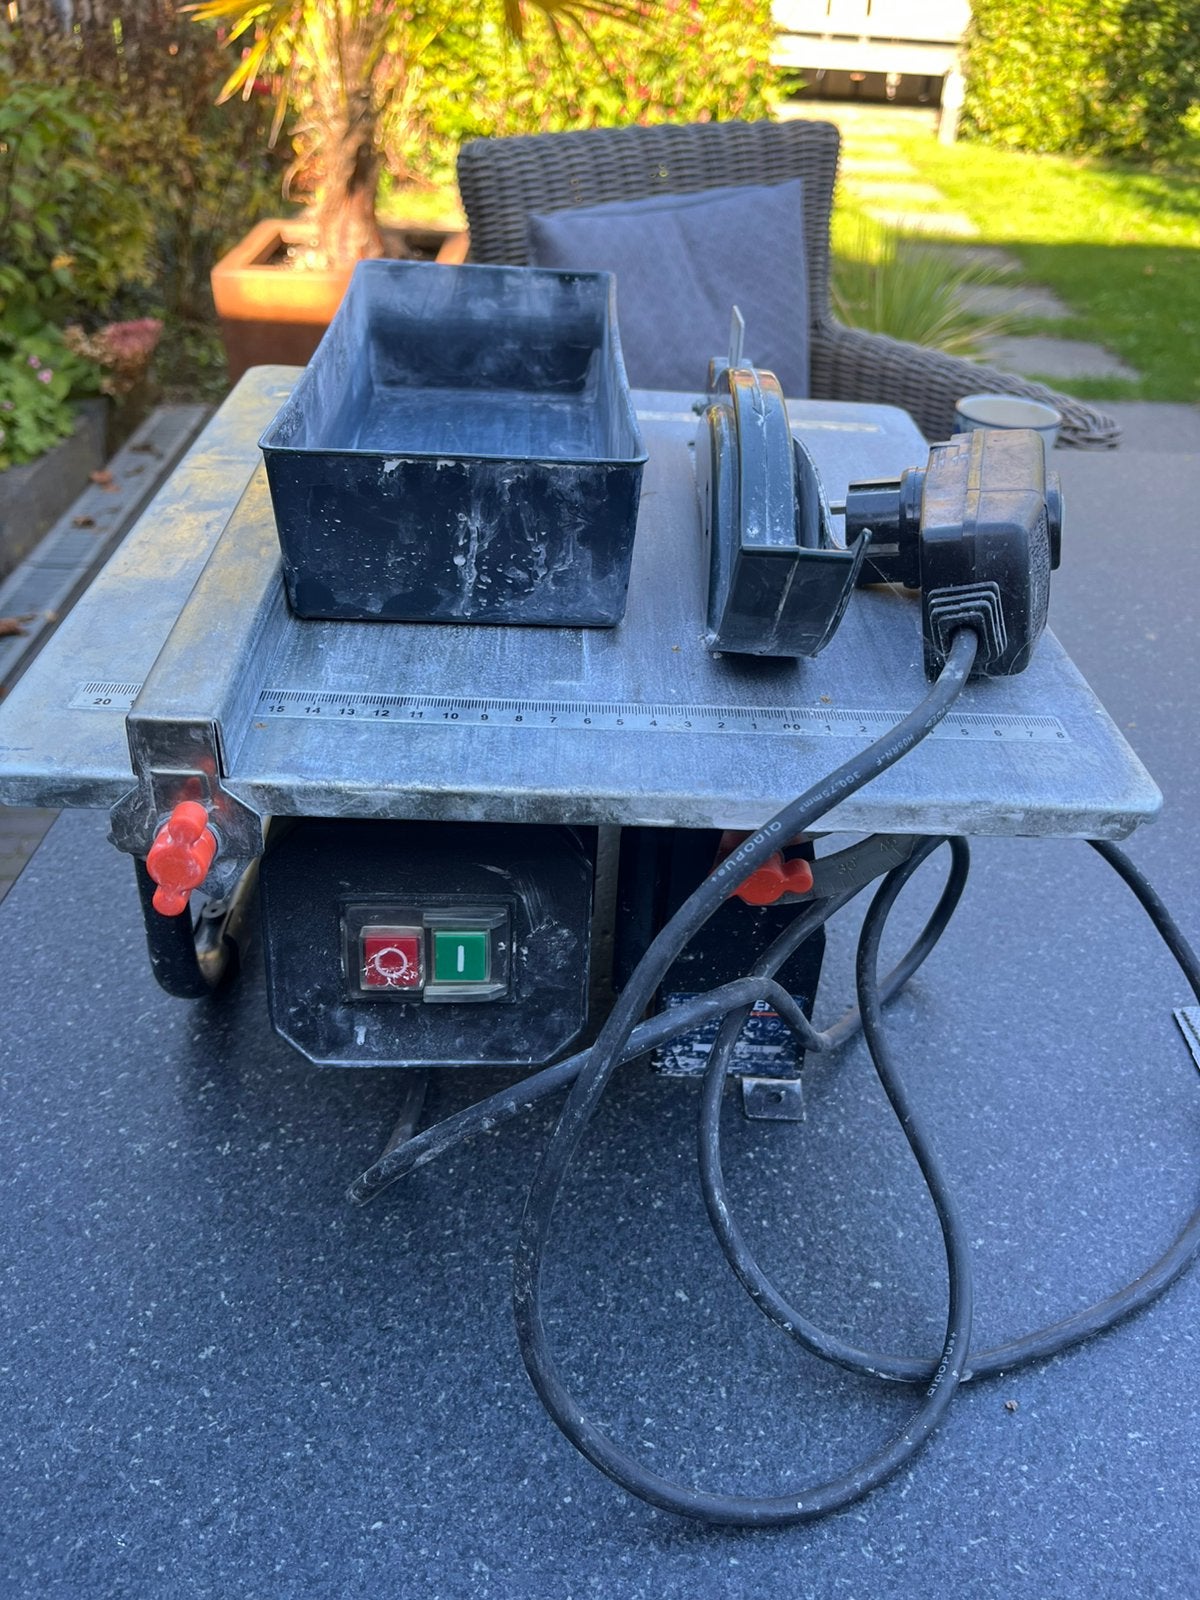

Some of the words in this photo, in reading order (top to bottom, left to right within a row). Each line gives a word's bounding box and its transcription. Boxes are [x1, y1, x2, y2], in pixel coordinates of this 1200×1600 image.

[92, 697, 112, 706] 20
[268, 705, 285, 713] 15
[304, 706, 321, 714] 14
[339, 708, 355, 716] 13
[373, 709, 390, 717] 12
[409, 711, 424, 719] 11
[442, 712, 459, 720] 10
[480, 713, 489, 721] 9
[549, 716, 557, 724] 7
[718, 721, 726, 729] 2
[859, 725, 867, 733] 2
[960, 728, 969, 736] 5
[1025, 730, 1034, 738] 7
[1055, 731, 1065, 739] 8
